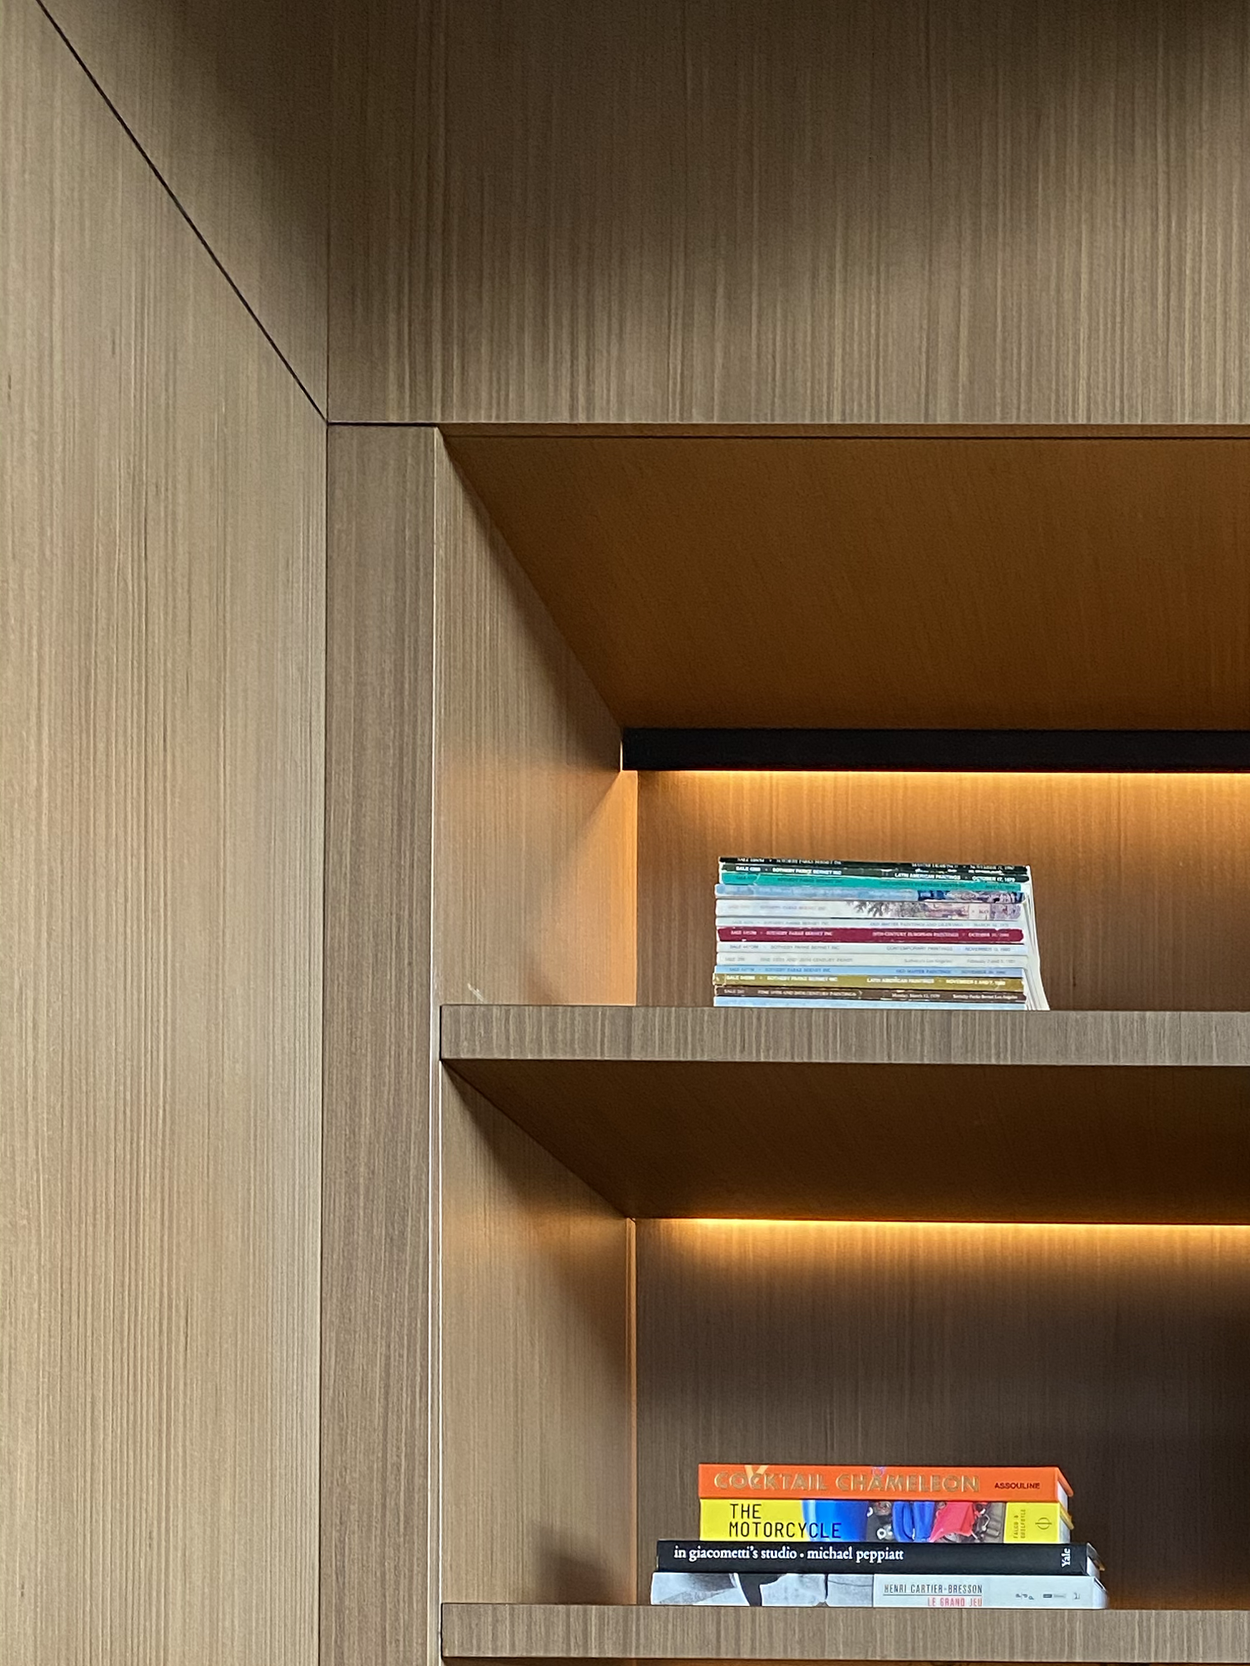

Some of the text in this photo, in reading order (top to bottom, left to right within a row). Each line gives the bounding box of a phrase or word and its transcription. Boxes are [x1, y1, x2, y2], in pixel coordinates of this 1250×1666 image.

[714, 1472, 980, 1493] COCKTAIL CHAMELEON
[994, 1482, 1041, 1490] ASSOULINE
[730, 1503, 762, 1519] THE
[729, 1521, 842, 1539] MOTORCYCLE
[673, 1545, 904, 1563] in giacometti's studio michael peppiatt
[1061, 1547, 1071, 1568] Yale
[884, 1584, 983, 1594] HENRI CARTIER-BRESSON
[928, 1598, 983, 1606] LE GRAND JEU
